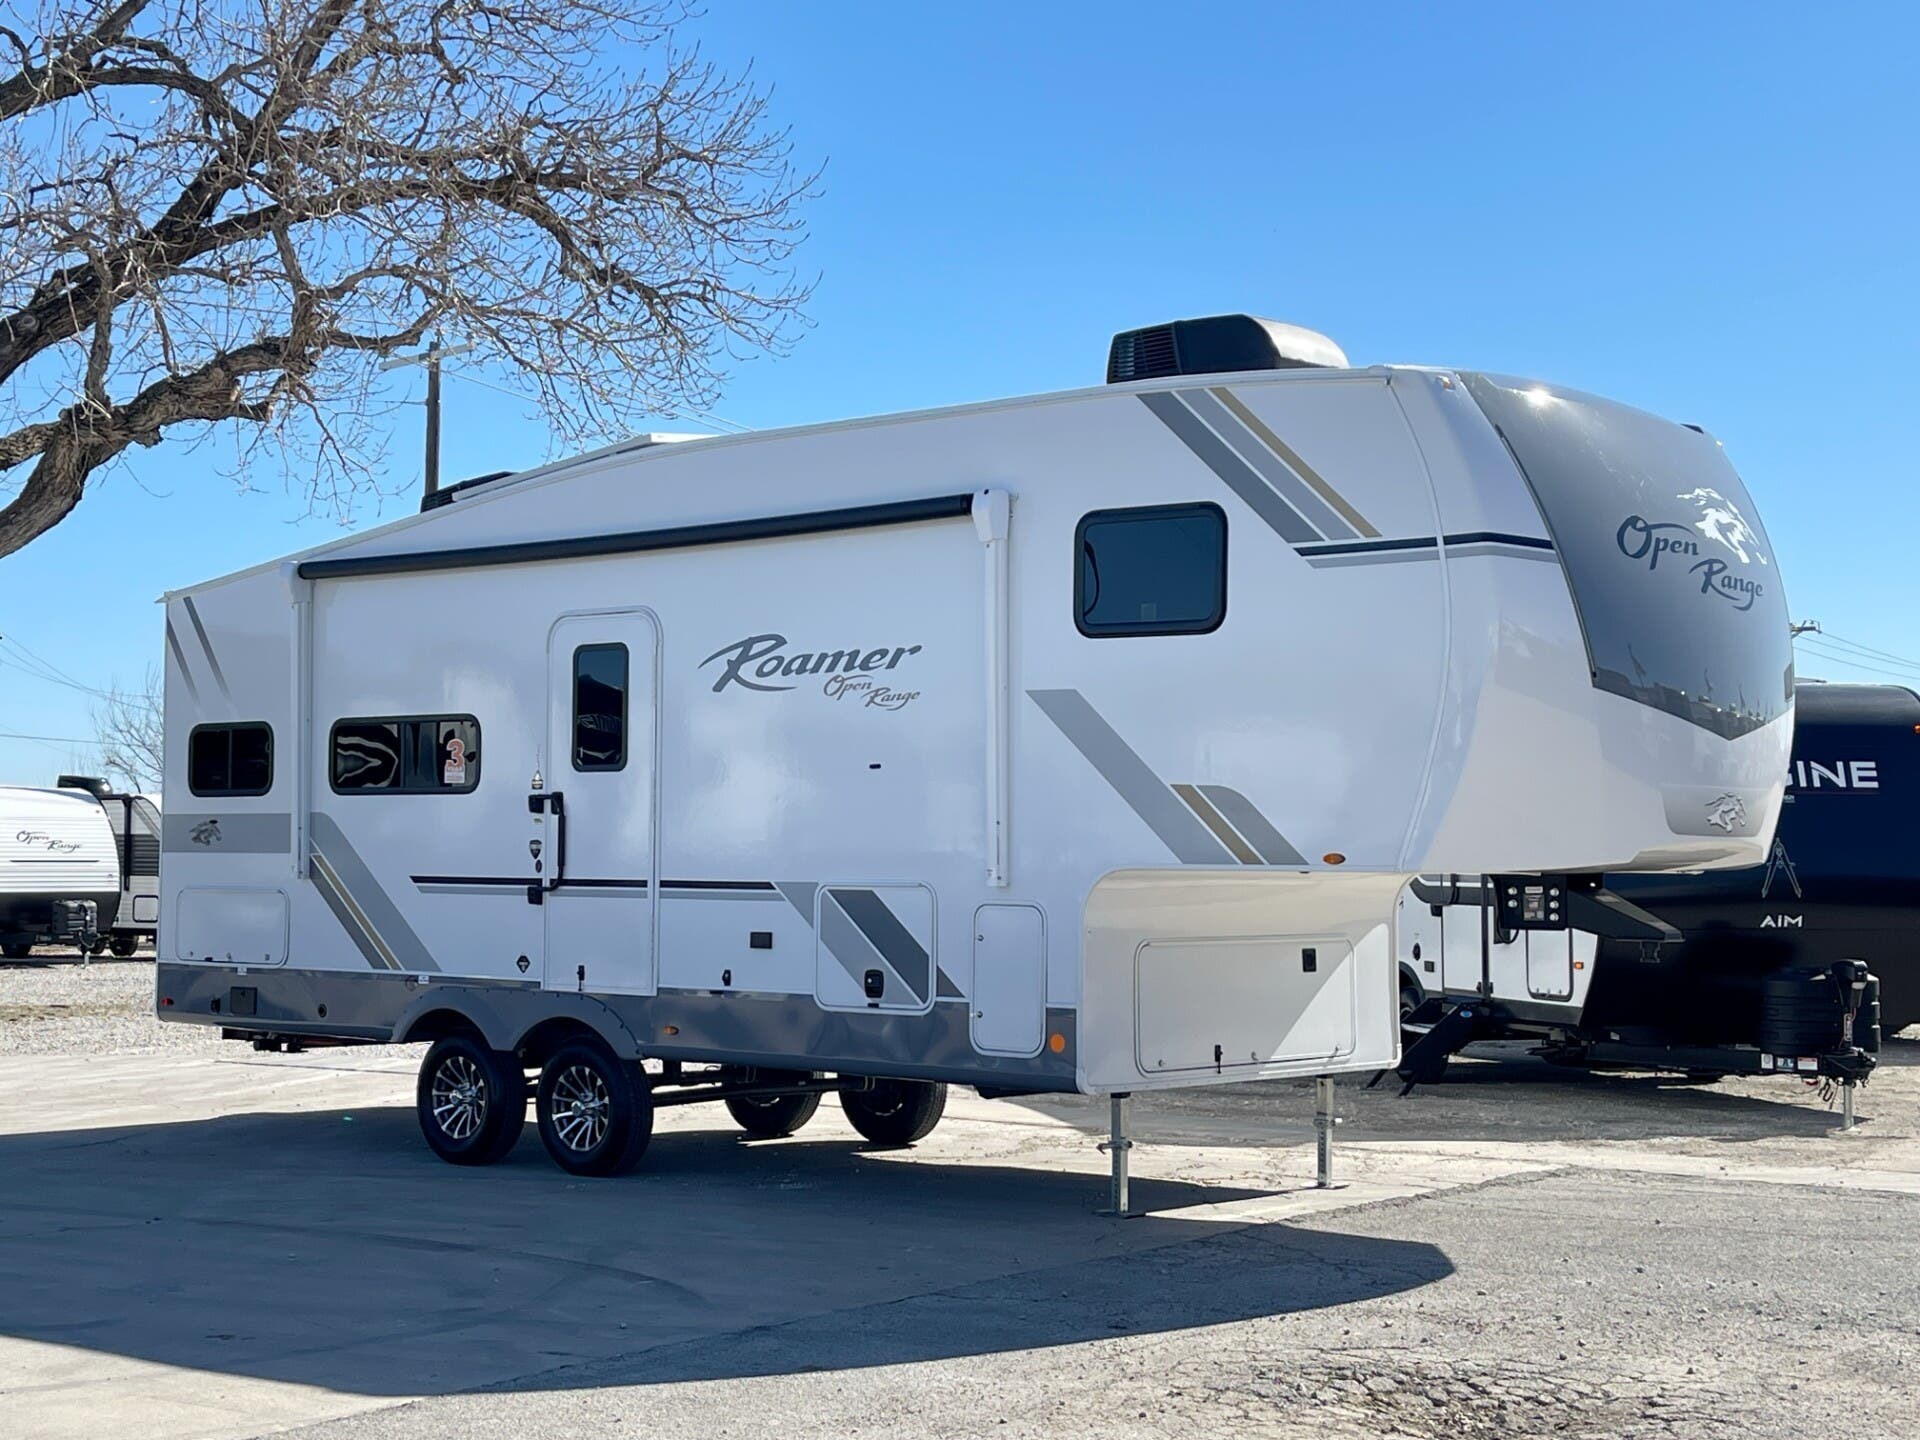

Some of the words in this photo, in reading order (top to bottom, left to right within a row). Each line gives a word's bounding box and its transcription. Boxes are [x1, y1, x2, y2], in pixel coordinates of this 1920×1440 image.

[1616, 515, 1699, 570] Open
[1688, 558, 1764, 611] Range
[697, 633, 923, 692] Roamer
[823, 674, 874, 701] Open
[861, 687, 921, 711] Range
[446, 738, 465, 768] 3
[1785, 761, 1879, 788] INE
[1760, 915, 1803, 928] AIM
